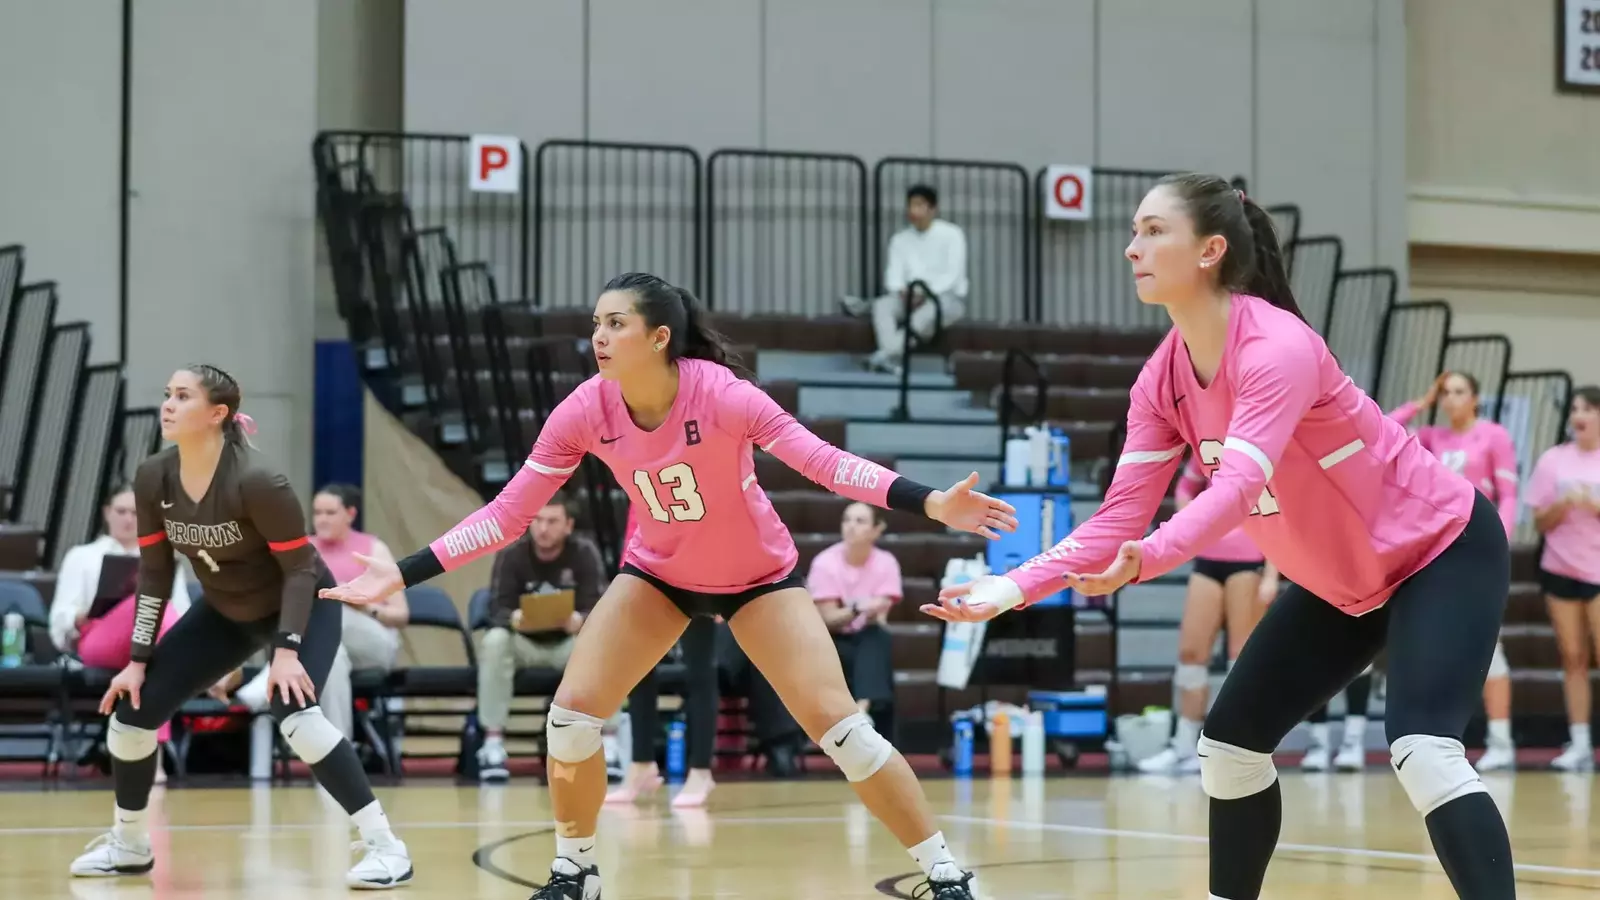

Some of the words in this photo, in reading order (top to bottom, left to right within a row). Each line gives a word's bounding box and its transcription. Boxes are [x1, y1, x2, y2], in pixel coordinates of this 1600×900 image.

[480, 145, 508, 181] P
[1054, 174, 1084, 211] Q
[685, 420, 701, 446] B
[833, 457, 880, 490] BEARS
[633, 462, 706, 523] 13
[165, 519, 243, 547] BROWN
[443, 516, 504, 558] BROWN
[197, 549, 220, 572] 1
[132, 594, 163, 646] BROWN
